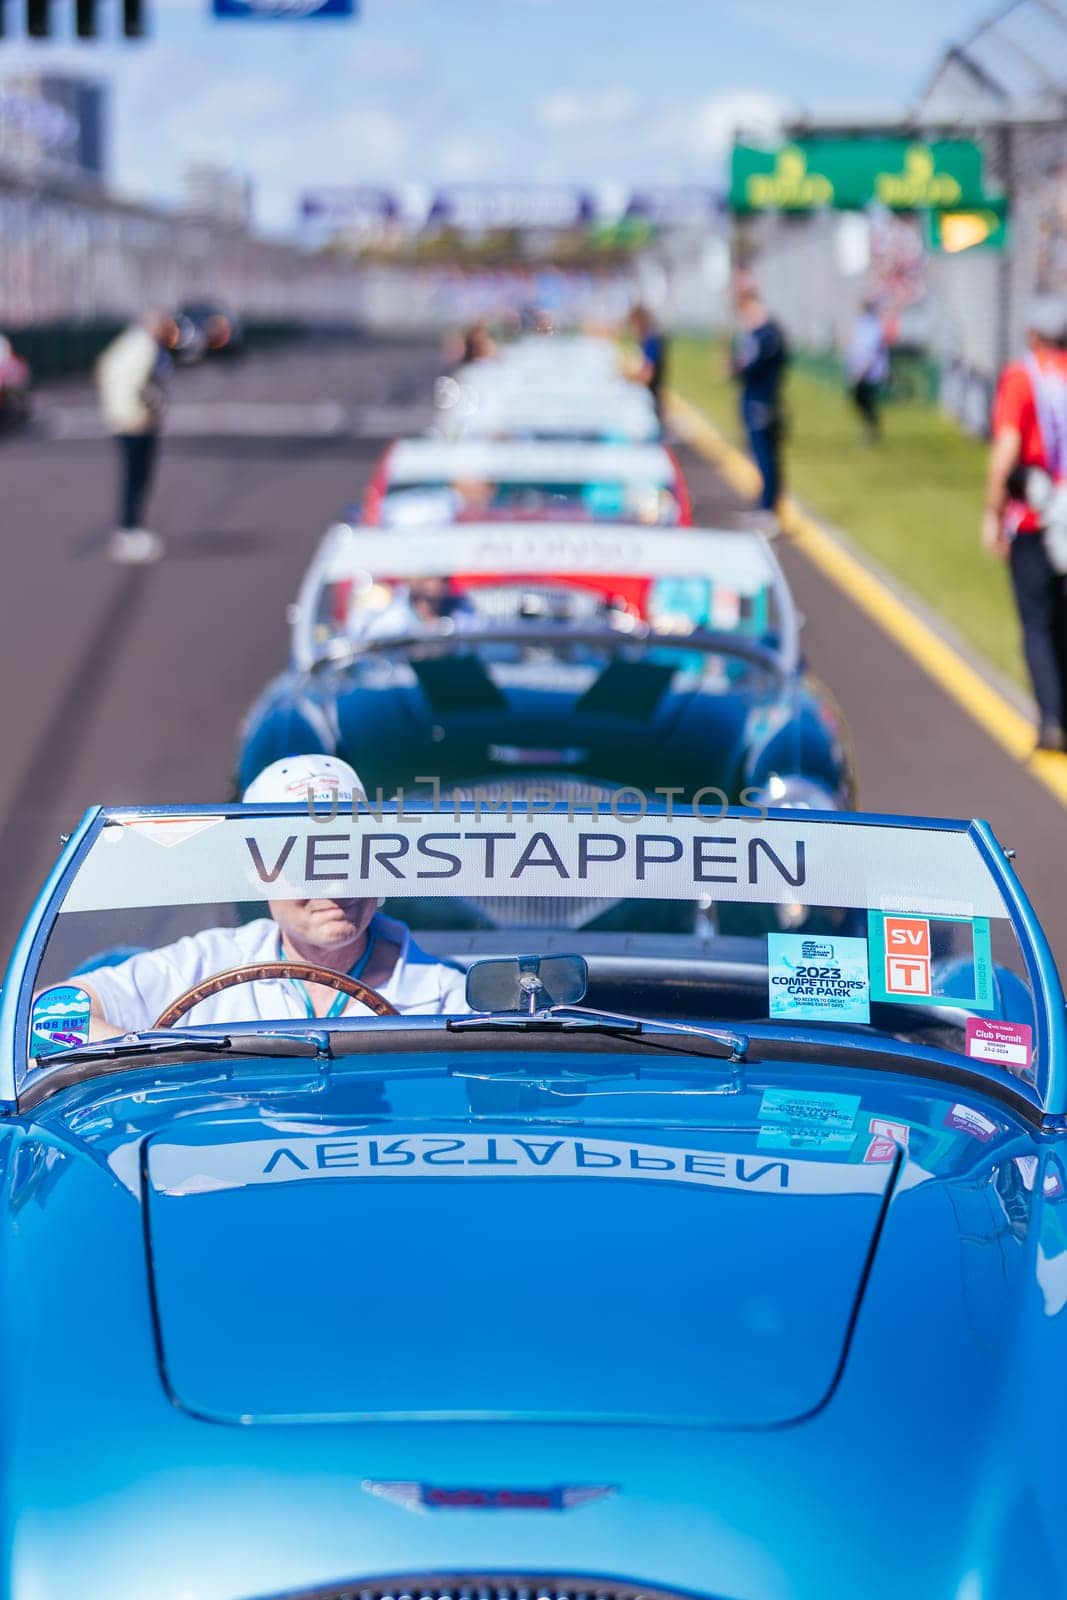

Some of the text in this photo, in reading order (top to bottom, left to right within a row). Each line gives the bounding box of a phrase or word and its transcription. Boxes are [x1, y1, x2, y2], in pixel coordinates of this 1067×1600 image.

[245, 831, 806, 888] VERSTAPPEN
[891, 929, 923, 946] SV
[795, 966, 842, 979] 2023
[895, 964, 921, 986] T
[787, 986, 852, 998] CAR PARK
[976, 1029, 1022, 1043] Club Permit
